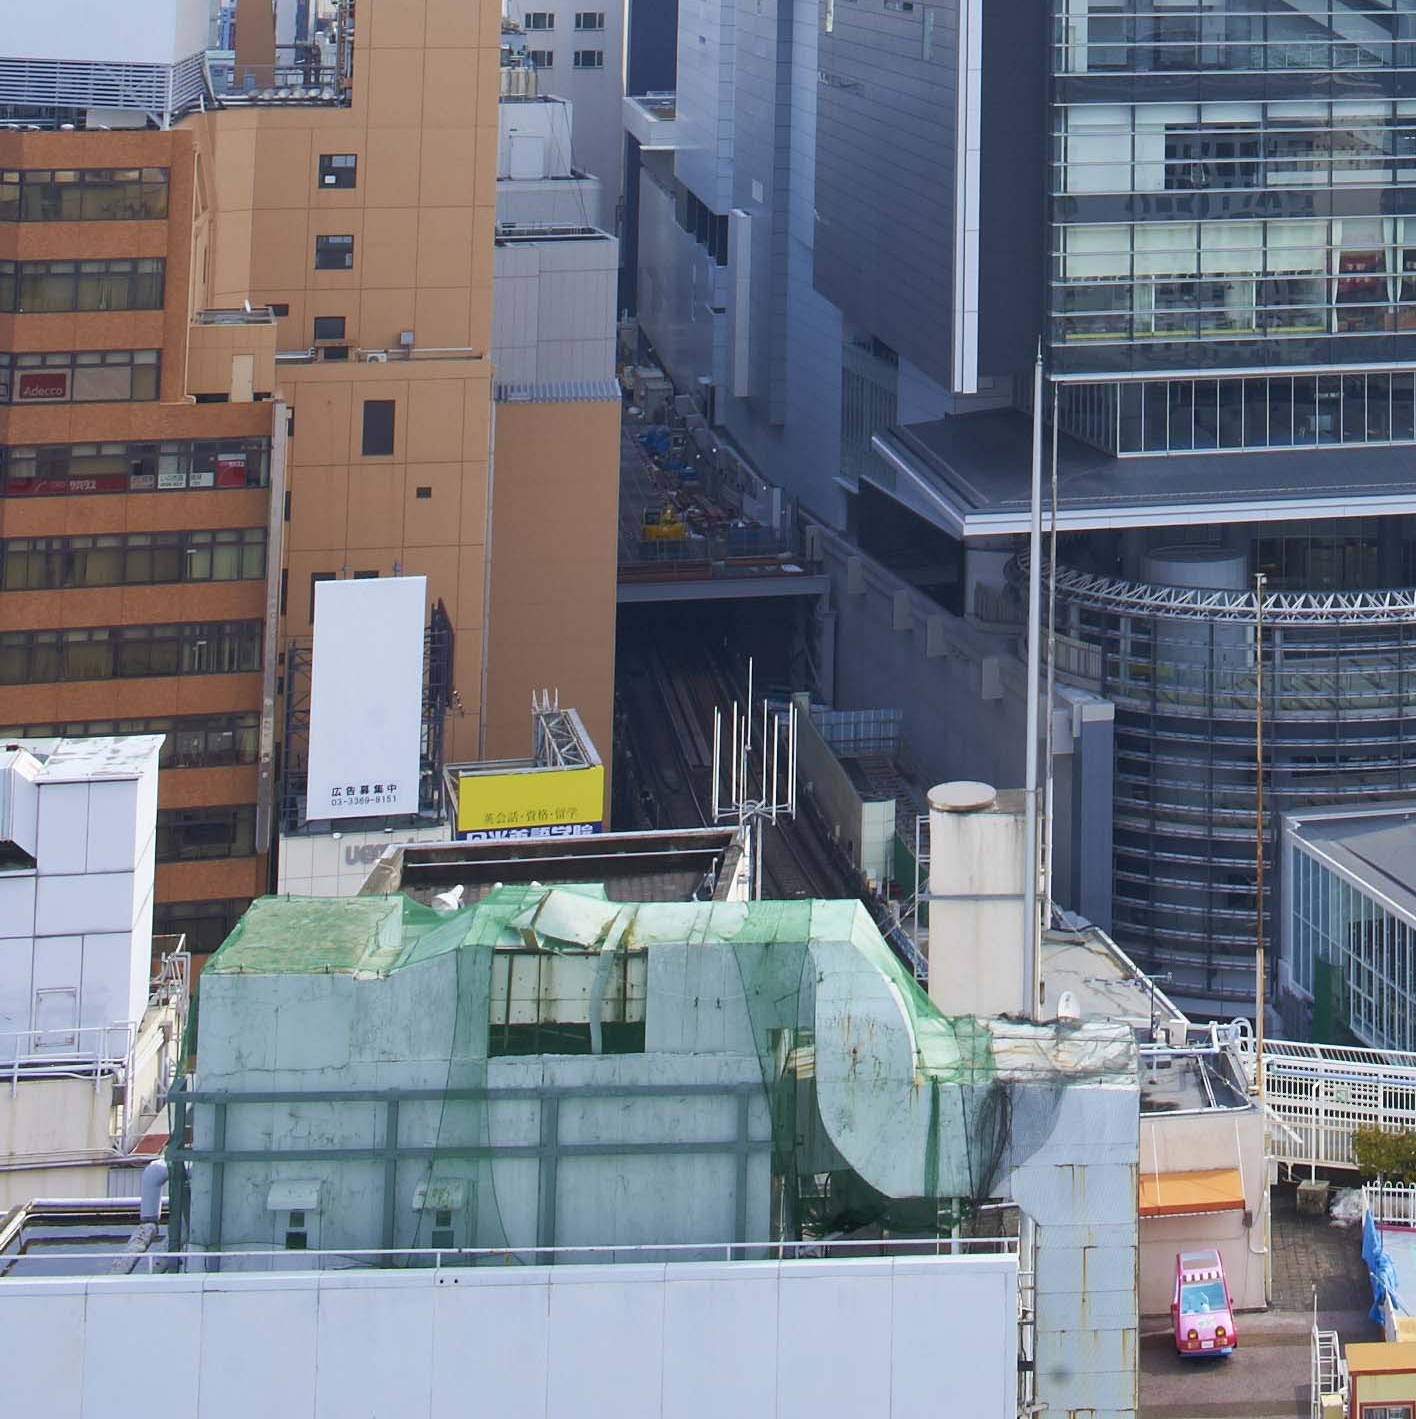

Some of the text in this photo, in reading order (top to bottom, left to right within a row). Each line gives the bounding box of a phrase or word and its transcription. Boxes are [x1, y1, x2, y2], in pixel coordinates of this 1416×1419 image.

[22, 386, 63, 396] Adecco
[331, 784, 398, 797] 広告募集中
[331, 794, 397, 806] 03-3369-8151
